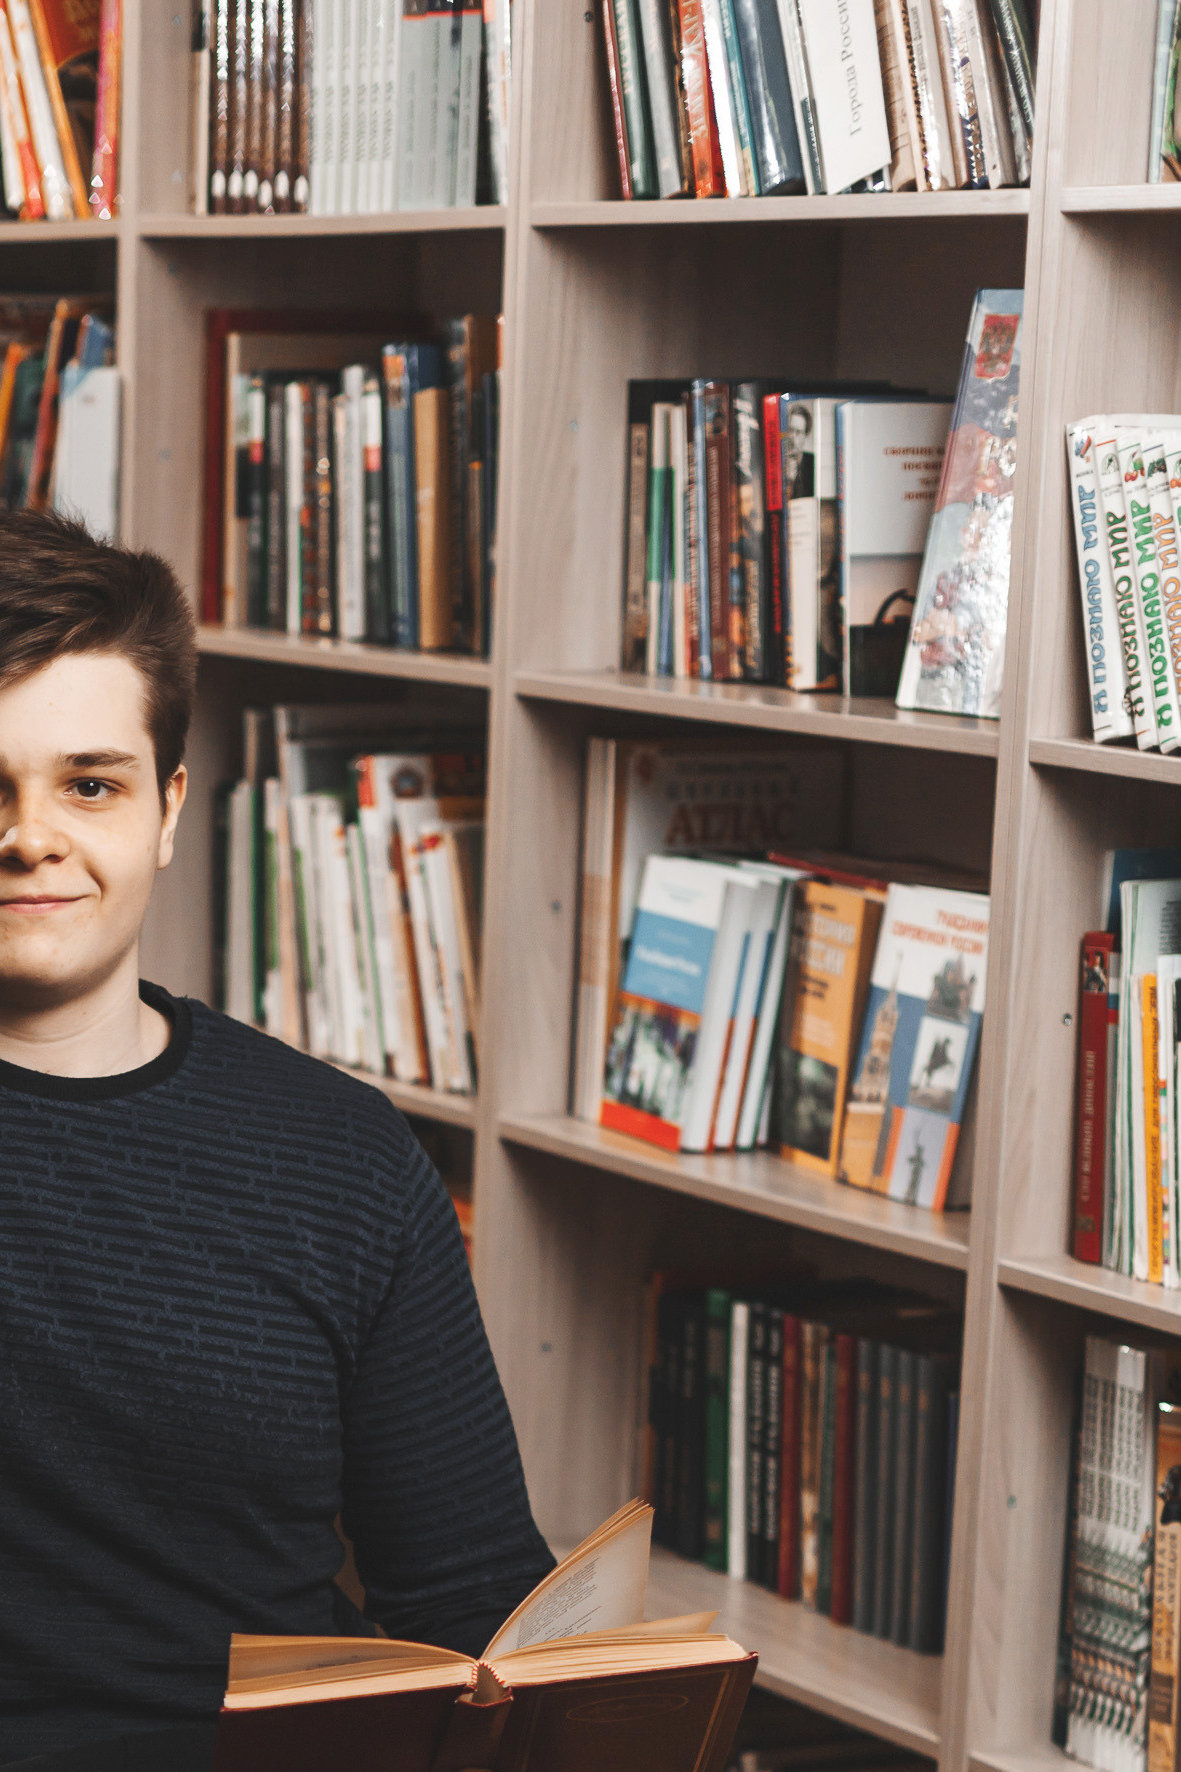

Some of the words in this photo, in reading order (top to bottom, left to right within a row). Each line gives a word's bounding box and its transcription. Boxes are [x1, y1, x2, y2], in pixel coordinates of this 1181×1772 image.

[837, 0, 854, 62] Росси
[846, 65, 862, 137] Города
[1078, 485, 1098, 551] МИР
[1106, 511, 1130, 570] МИР
[1130, 500, 1156, 567] МИР
[1153, 512, 1179, 571] МИР
[1084, 559, 1107, 684] ПОЗНАЮ
[1116, 575, 1141, 691] ПОЗНАЮ
[1140, 572, 1169, 698] ПОЗНАЮ
[1093, 689, 1108, 714] Я
[1156, 703, 1172, 729] Я
